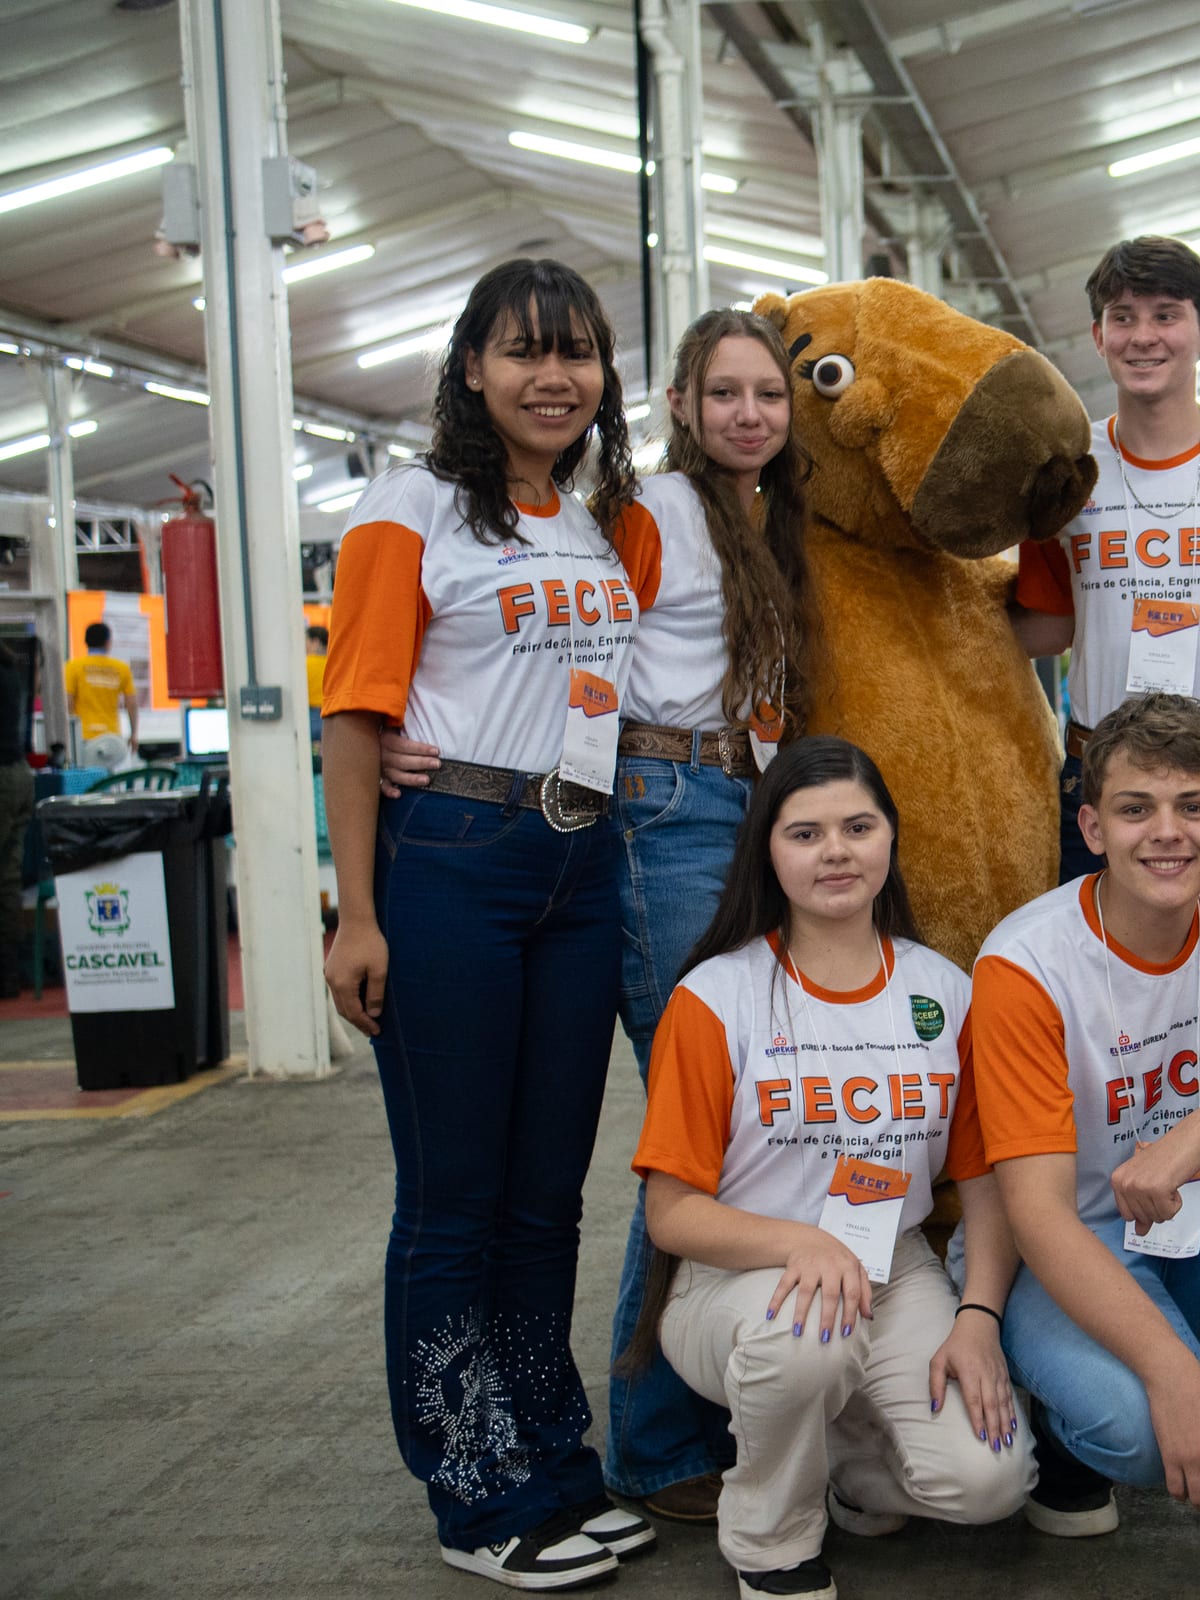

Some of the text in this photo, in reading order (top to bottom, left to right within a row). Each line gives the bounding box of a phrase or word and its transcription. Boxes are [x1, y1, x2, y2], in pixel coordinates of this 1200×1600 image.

[1103, 578, 1116, 588] de
[1121, 592, 1127, 600] e
[496, 579, 640, 635] FECE
[544, 638, 559, 650] de
[558, 655, 564, 664] e
[66, 951, 165, 970] CASCAVEL
[917, 1010, 939, 1020] CEEP
[1143, 1032, 1168, 1046] EUREKA
[832, 1044, 854, 1052] Escola
[855, 1043, 864, 1051] de
[865, 1042, 901, 1051] Tecnologa
[755, 1072, 955, 1127] FECET
[1153, 1126, 1160, 1134] e
[803, 1134, 819, 1145] de
[821, 1151, 828, 1160] e
